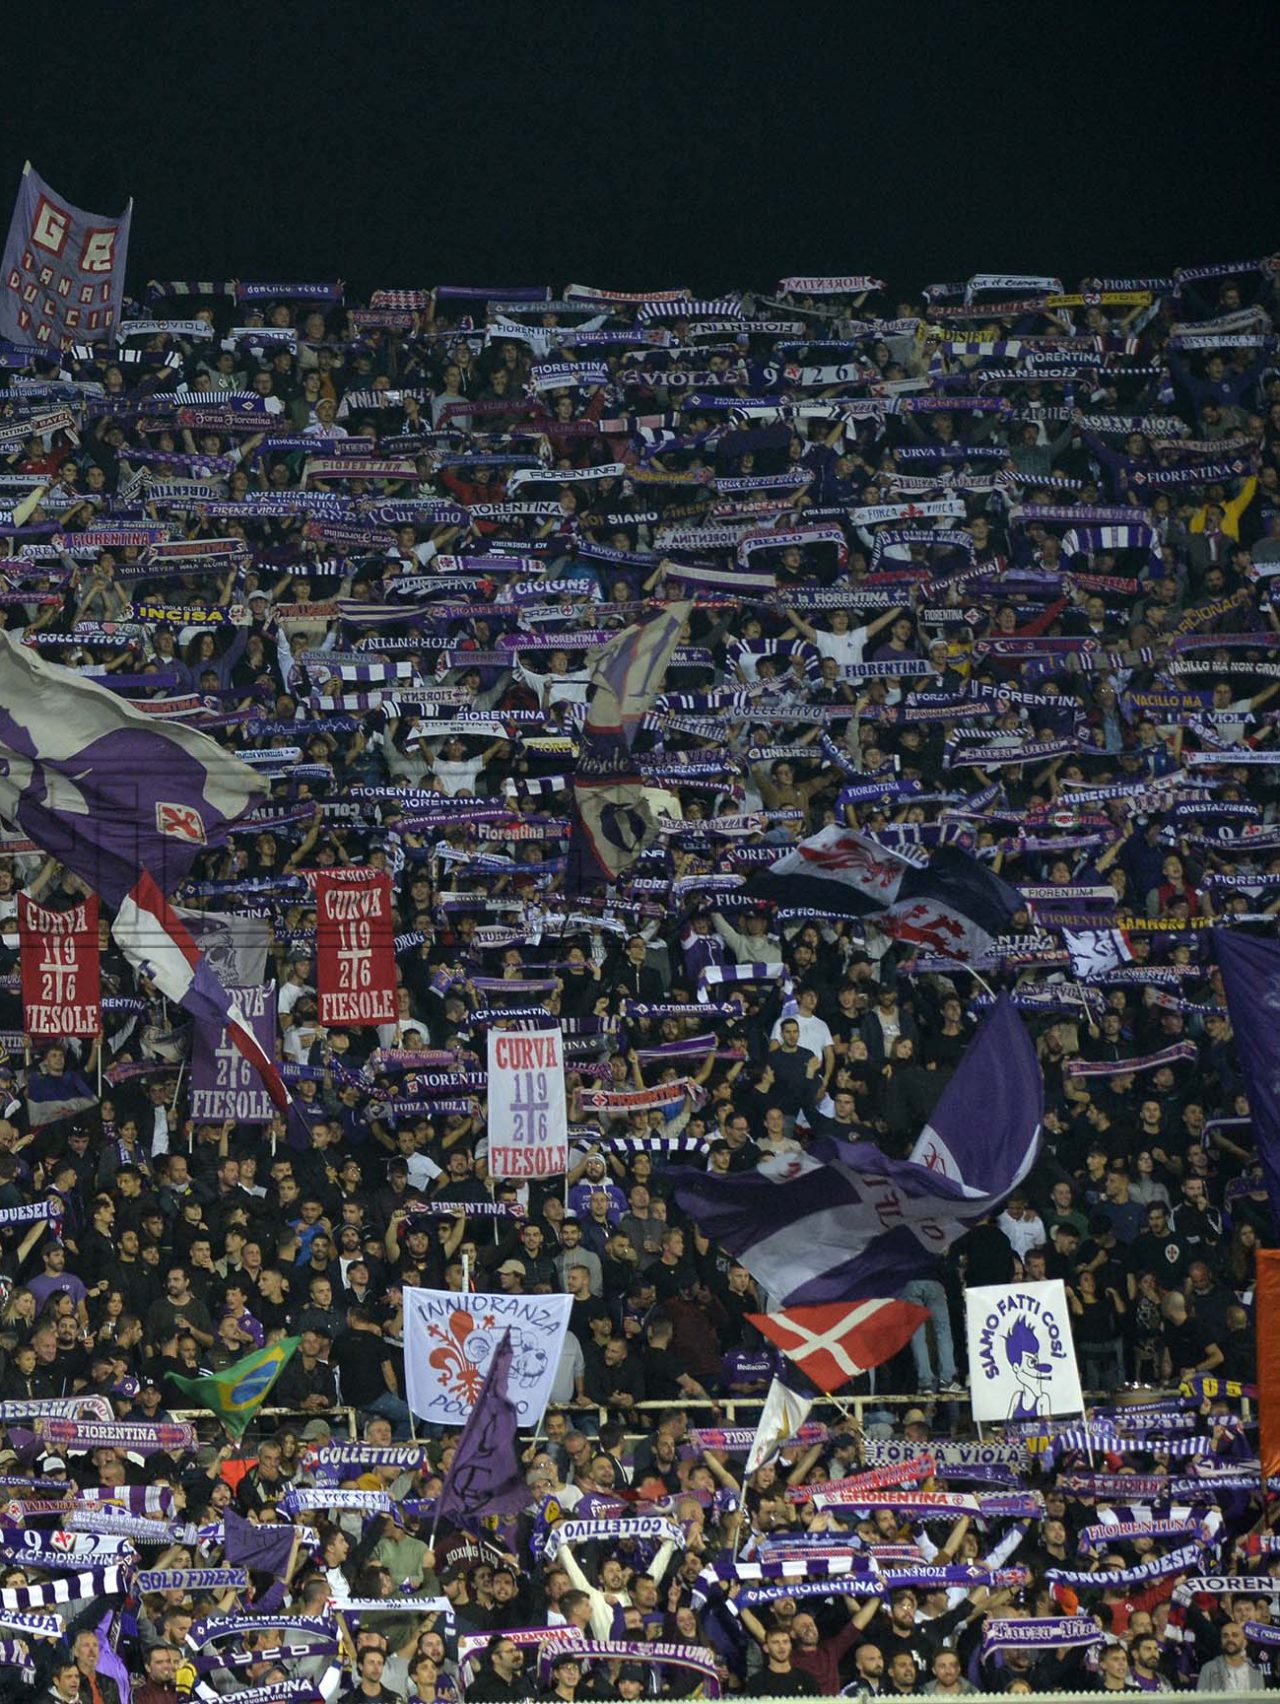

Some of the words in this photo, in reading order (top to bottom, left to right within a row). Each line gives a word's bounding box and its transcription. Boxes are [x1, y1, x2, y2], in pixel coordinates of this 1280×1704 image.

[531, 362, 609, 375] FIORENTINA
[644, 372, 719, 386] VIOLA
[322, 461, 402, 471] FIORENTINA
[530, 466, 617, 479] FIORENTINA
[1147, 463, 1231, 484] FIORENTINA
[608, 513, 658, 525] SIAMO
[514, 578, 589, 594] CICLONE
[813, 591, 889, 603] FIORENTINA
[139, 608, 224, 623] INCISA
[39, 633, 126, 644] COLLETTIVO
[548, 633, 599, 644] FIORENTINA
[846, 661, 927, 678] FIORENTINA
[1207, 713, 1256, 723] VIOLA
[350, 787, 441, 798] FIORENTINA
[847, 780, 899, 797] FIORENTINA
[478, 823, 544, 841] Fiorentina
[1028, 888, 1094, 897] FIORENTINA
[325, 888, 382, 919] CURVA
[322, 990, 395, 1018] FIESOLE
[495, 1036, 558, 1070] CURVA
[193, 1090, 273, 1120] FIESOLE
[490, 1145, 567, 1176] FIESOLE
[976, 1313, 1000, 1380] SIAMO
[996, 1293, 1042, 1315] FATTI
[76, 1424, 158, 1442] FIORENTINA
[319, 1446, 420, 1467] COLLETTIVO
[875, 1445, 946, 1463] FORZA
[960, 1449, 1020, 1463] VIOLA
[138, 1570, 184, 1592] SOLO
[218, 1678, 313, 1703] FIORENTINA
